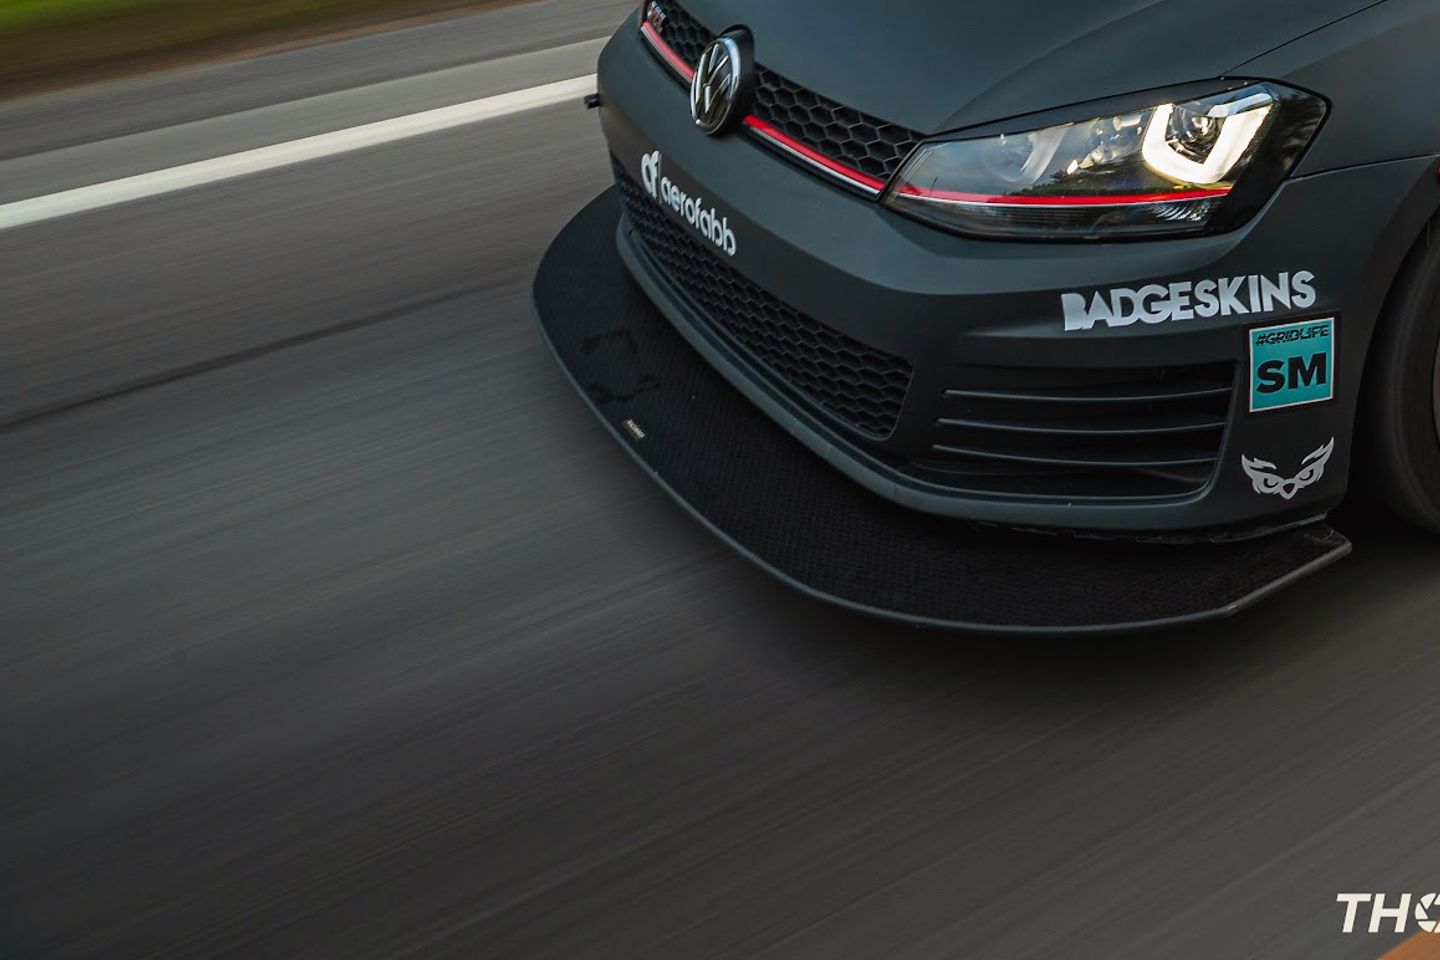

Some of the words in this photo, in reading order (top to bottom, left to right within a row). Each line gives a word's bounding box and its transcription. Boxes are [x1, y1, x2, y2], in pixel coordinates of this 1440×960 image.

[661, 176, 737, 256] aerofabb
[1061, 270, 1316, 331] BADGESKINS
[1256, 324, 1330, 346] #GRIDLIFE
[1256, 352, 1327, 394] SM
